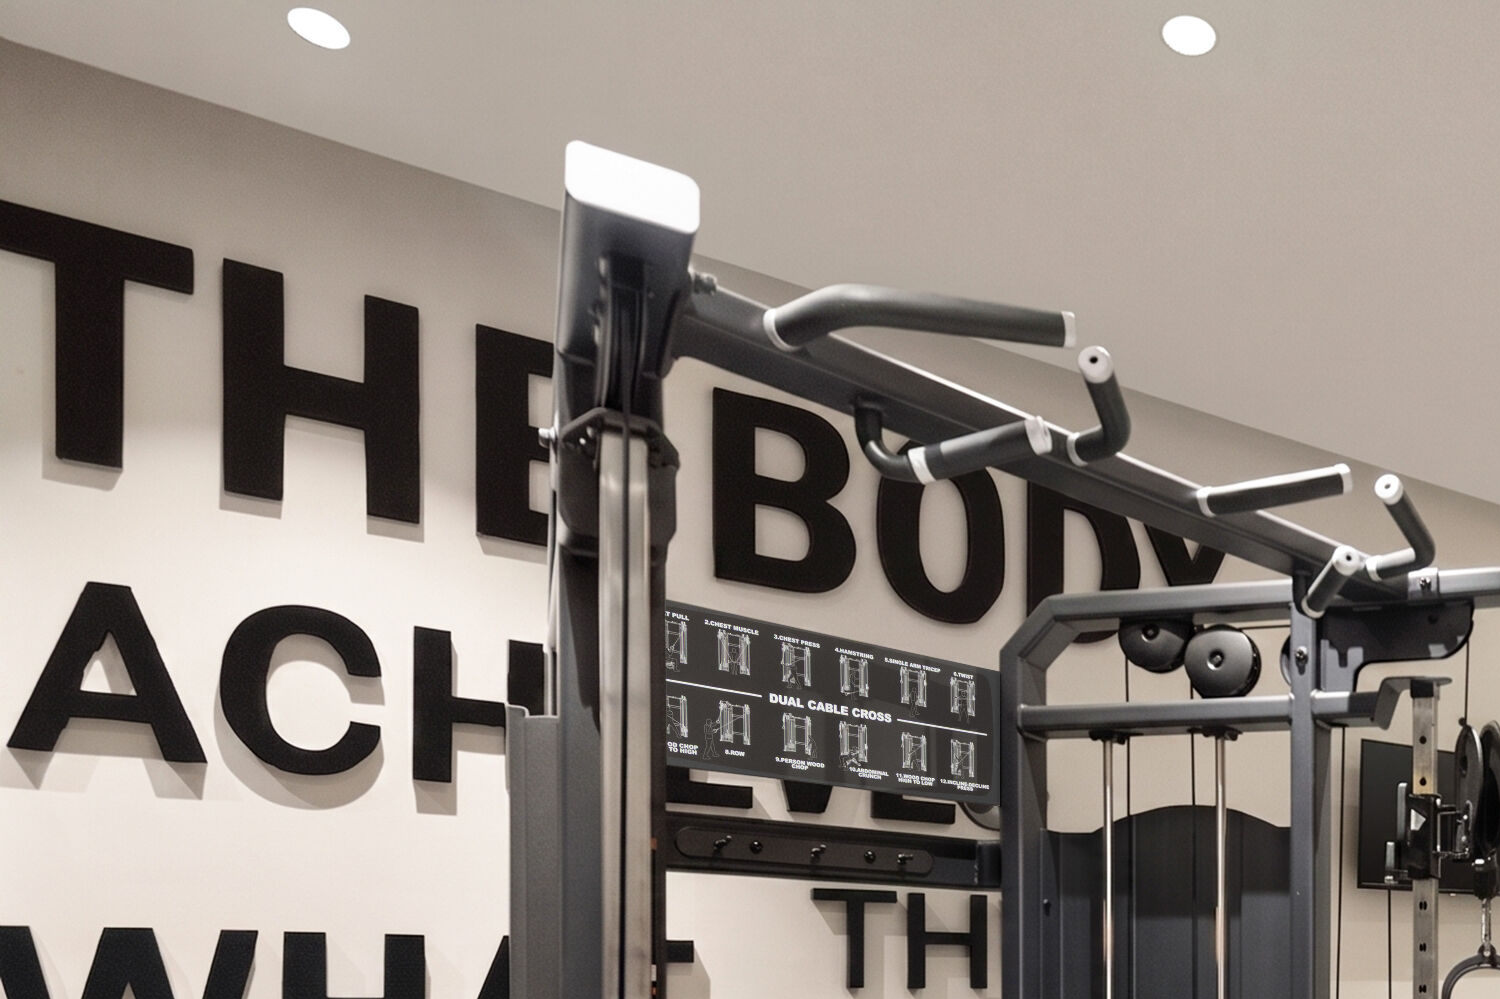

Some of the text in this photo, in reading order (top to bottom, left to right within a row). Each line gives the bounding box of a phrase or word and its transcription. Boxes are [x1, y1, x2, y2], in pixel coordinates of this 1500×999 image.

[671, 612, 690, 621] PULL
[704, 619, 759, 636] 2.CHEST MUSCLE
[773, 634, 820, 649] 3.CHEST PRESS
[834, 647, 874, 660] 4.HAMSTRING
[909, 662, 921, 670] ARM
[922, 665, 941, 673] TRICEP
[769, 692, 892, 723] DUAL CABLE CROSS
[678, 742, 699, 750] CHOP
[679, 748, 698, 756] HIGH
[724, 749, 746, 757] 8.ROW
[791, 763, 809, 771] CHOP
[806, 760, 825, 769] WOOD
[920, 775, 936, 783] CHOP
[812, 888, 988, 989] TH
